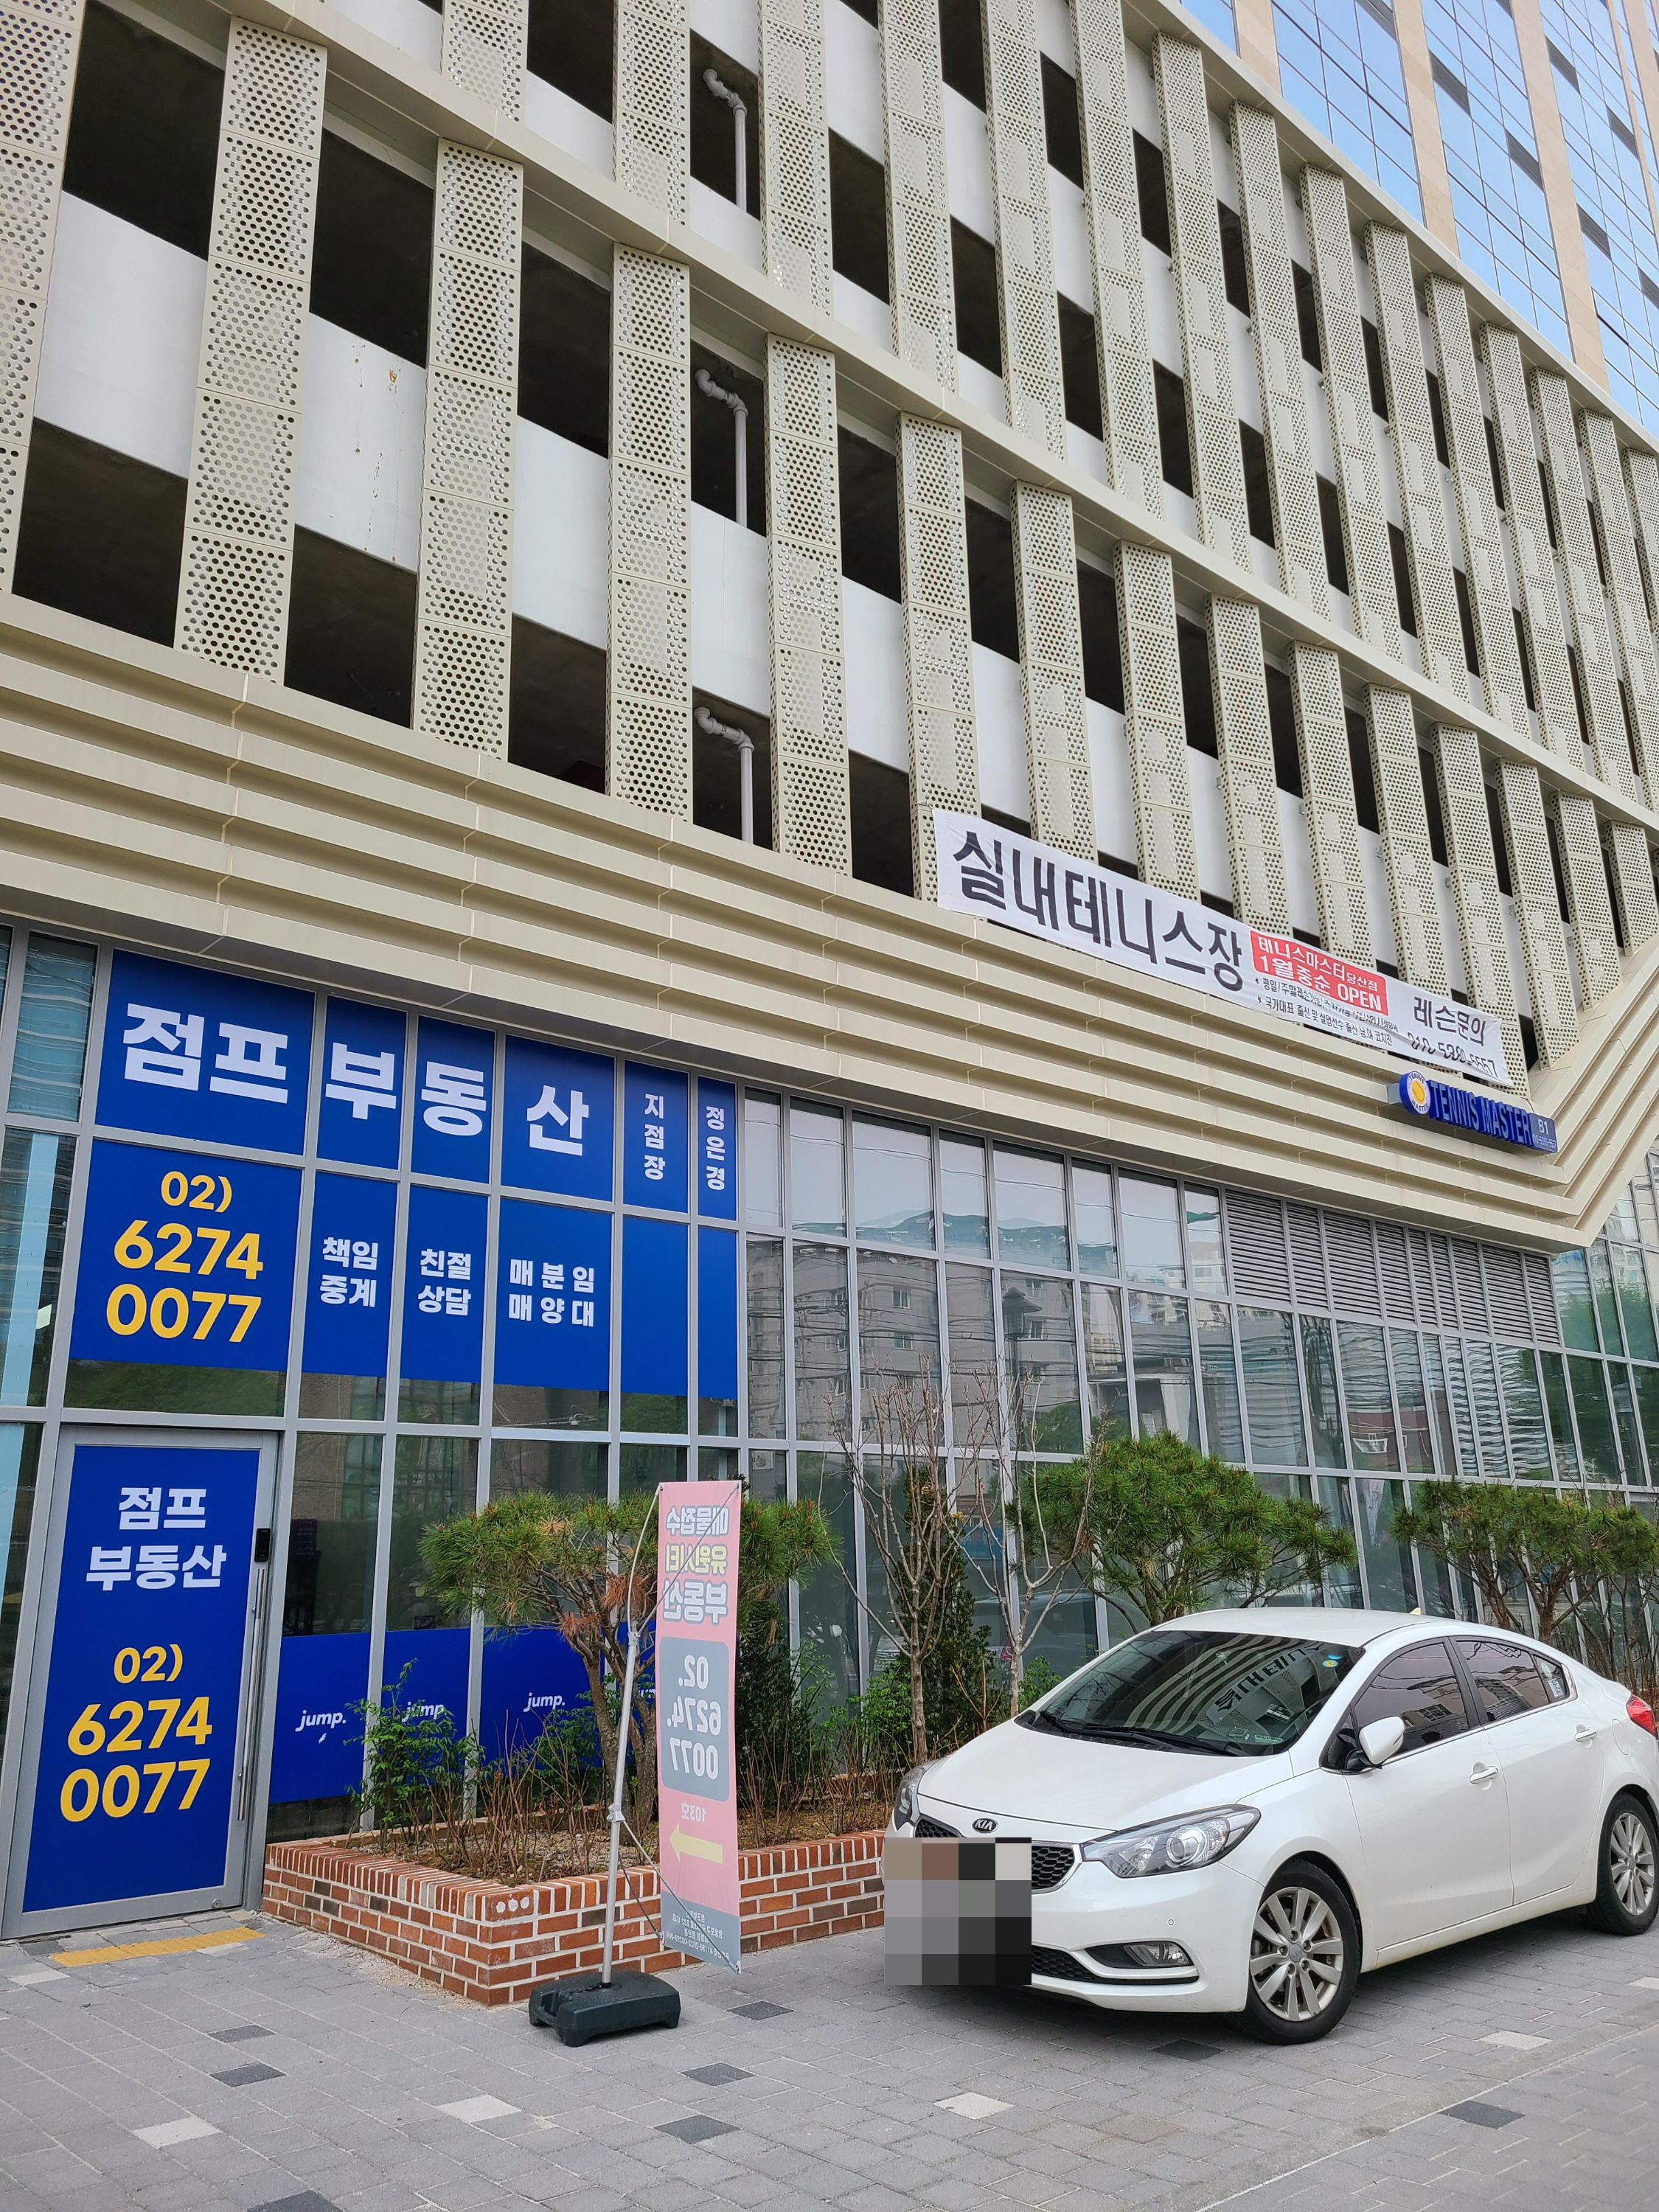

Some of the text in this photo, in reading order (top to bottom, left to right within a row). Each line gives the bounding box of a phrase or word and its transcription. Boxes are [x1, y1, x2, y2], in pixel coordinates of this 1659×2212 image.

[953, 830, 1243, 992] 실내테니스장
[1257, 936, 1378, 992] 테니스마스터 당산점
[1265, 995, 1295, 1015] 국가대표
[1296, 1004, 1311, 1020] 출신
[1312, 1010, 1319, 1023] 및
[1337, 982, 1382, 1012] OPEN
[1413, 996, 1486, 1047] 레슨문의
[122, 1002, 591, 1158] 점프 부동산
[1429, 1080, 1549, 1147] TENNIS MASTER B1
[643, 1093, 667, 1181] 지점장
[706, 1105, 727, 1192] 정은경
[160, 1170, 233, 1214] 02)
[113, 1220, 264, 1281] 6274
[321, 1235, 379, 1270] 책임
[419, 1248, 473, 1281] 친절
[105, 1283, 262, 1343] 0077
[319, 1274, 378, 1308] 중계
[417, 1284, 472, 1317] 상담
[118, 1486, 207, 1531] 점프
[86, 1545, 227, 1591] 부동산
[113, 1644, 184, 1685] 02)
[296, 1709, 347, 1732] jump.
[523, 1692, 566, 1713] jump.
[67, 1696, 213, 1757] 6274
[60, 1758, 211, 1823] 0077
[974, 1819, 993, 1831] KIA
